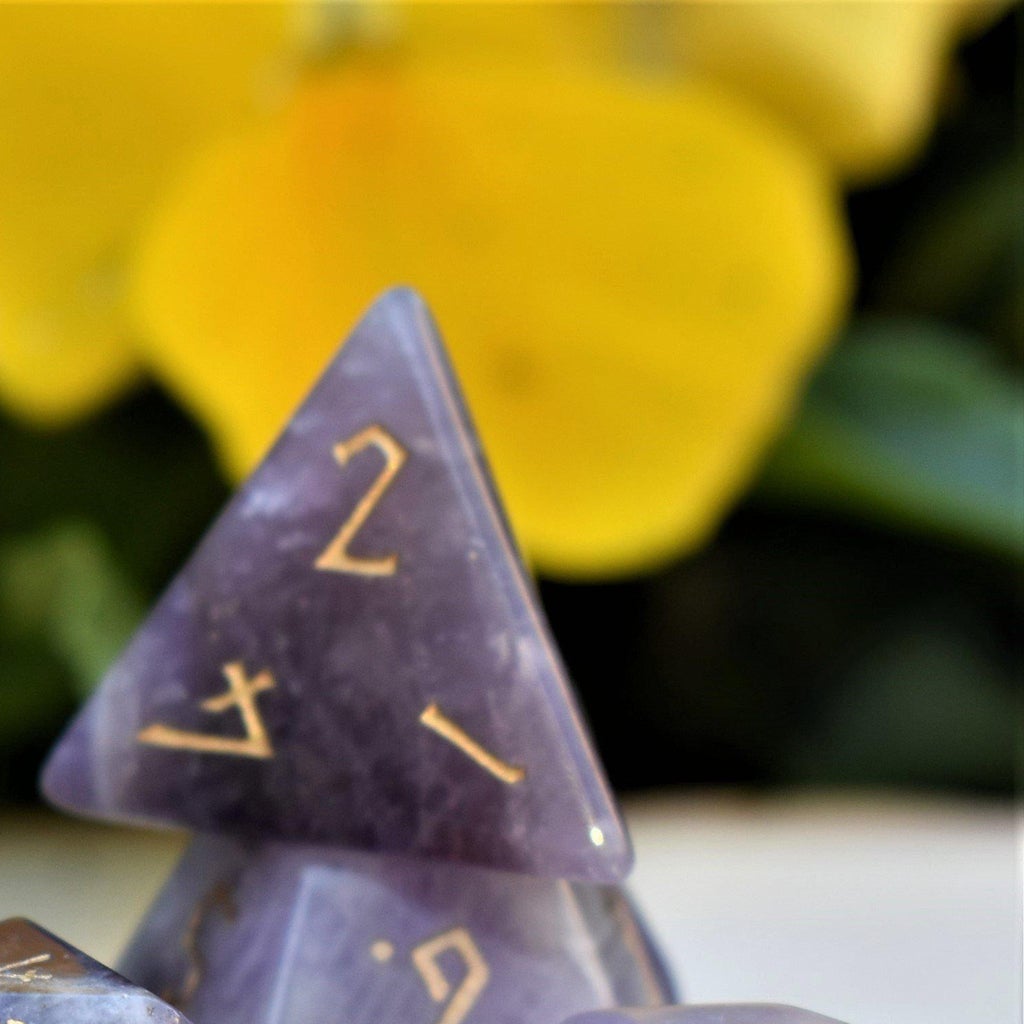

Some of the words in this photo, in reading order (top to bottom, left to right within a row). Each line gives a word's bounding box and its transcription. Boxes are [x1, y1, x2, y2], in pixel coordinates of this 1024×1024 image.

[315, 425, 408, 576] 2
[137, 663, 274, 758] 4
[420, 703, 526, 784] 1
